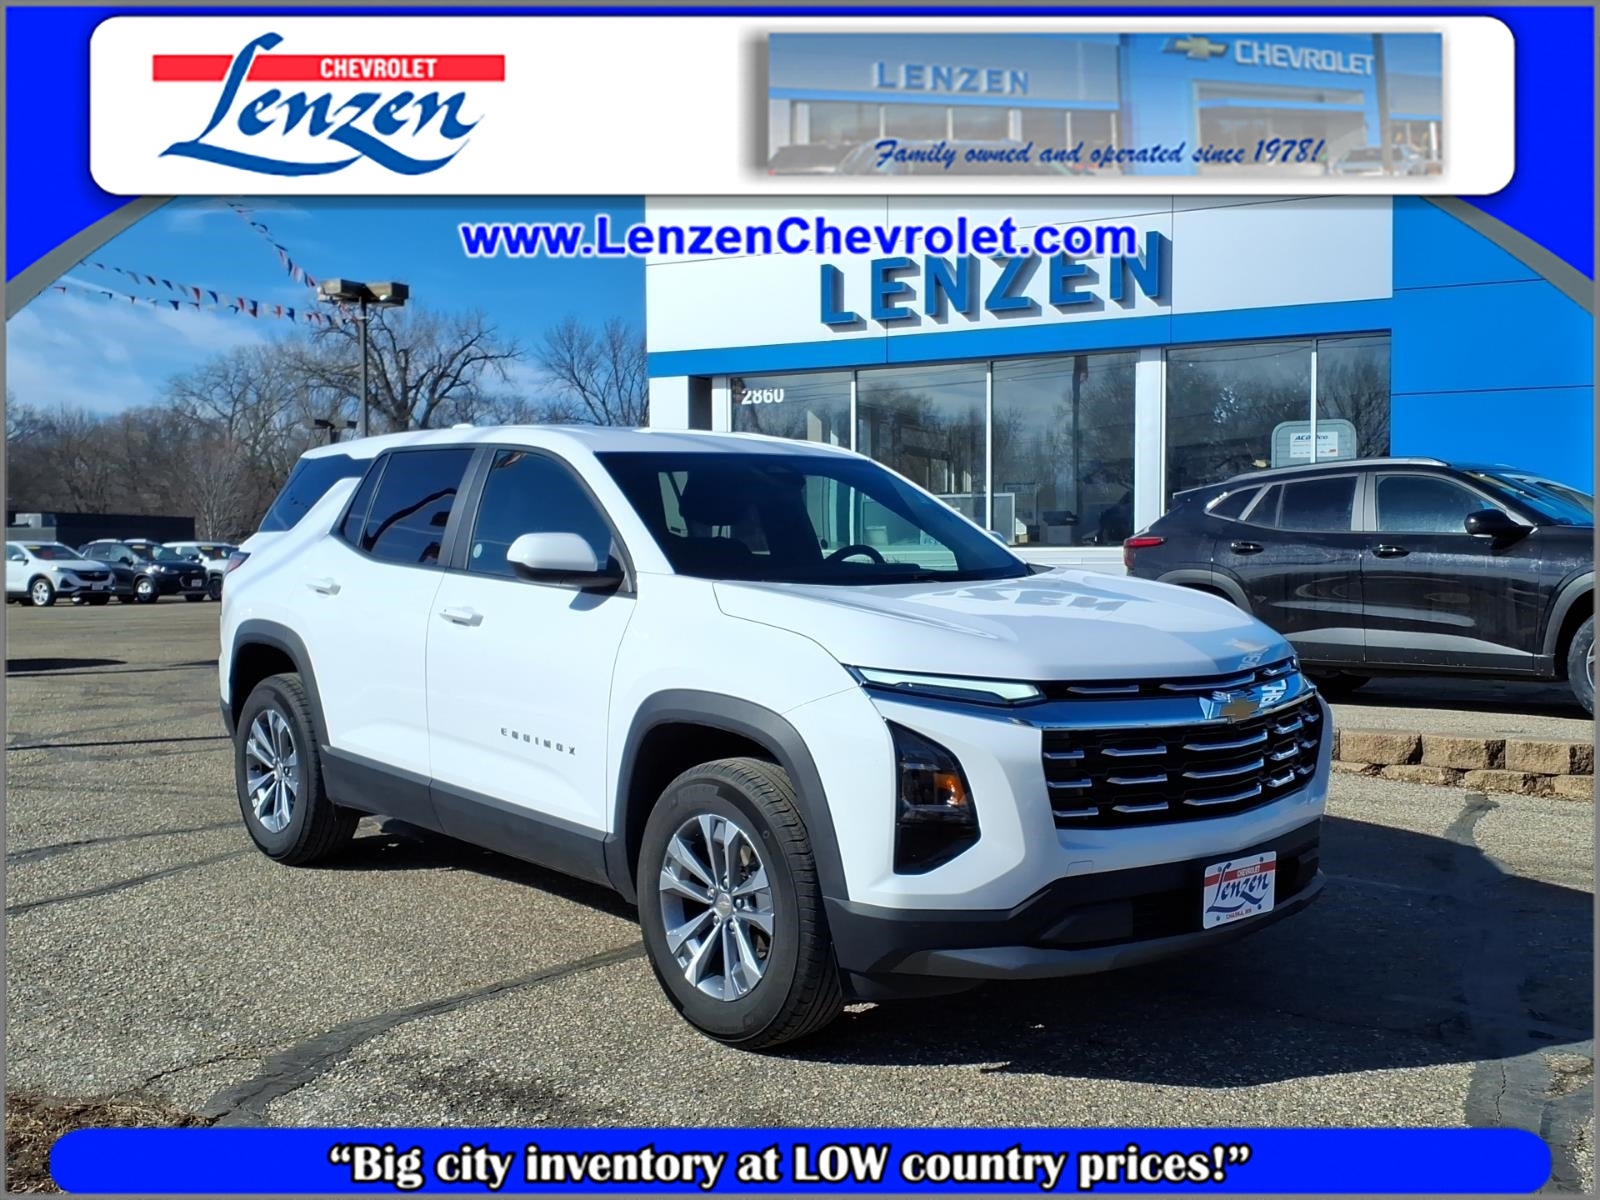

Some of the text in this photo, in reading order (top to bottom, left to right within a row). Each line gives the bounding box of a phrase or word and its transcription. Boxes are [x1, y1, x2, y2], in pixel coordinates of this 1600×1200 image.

[820, 230, 1162, 324] LENZEN
[741, 388, 785, 405] 2860
[500, 727, 576, 756] EQUINOX
[1236, 865, 1261, 878] CHEVROLET
[1205, 862, 1271, 914] Lenzen
